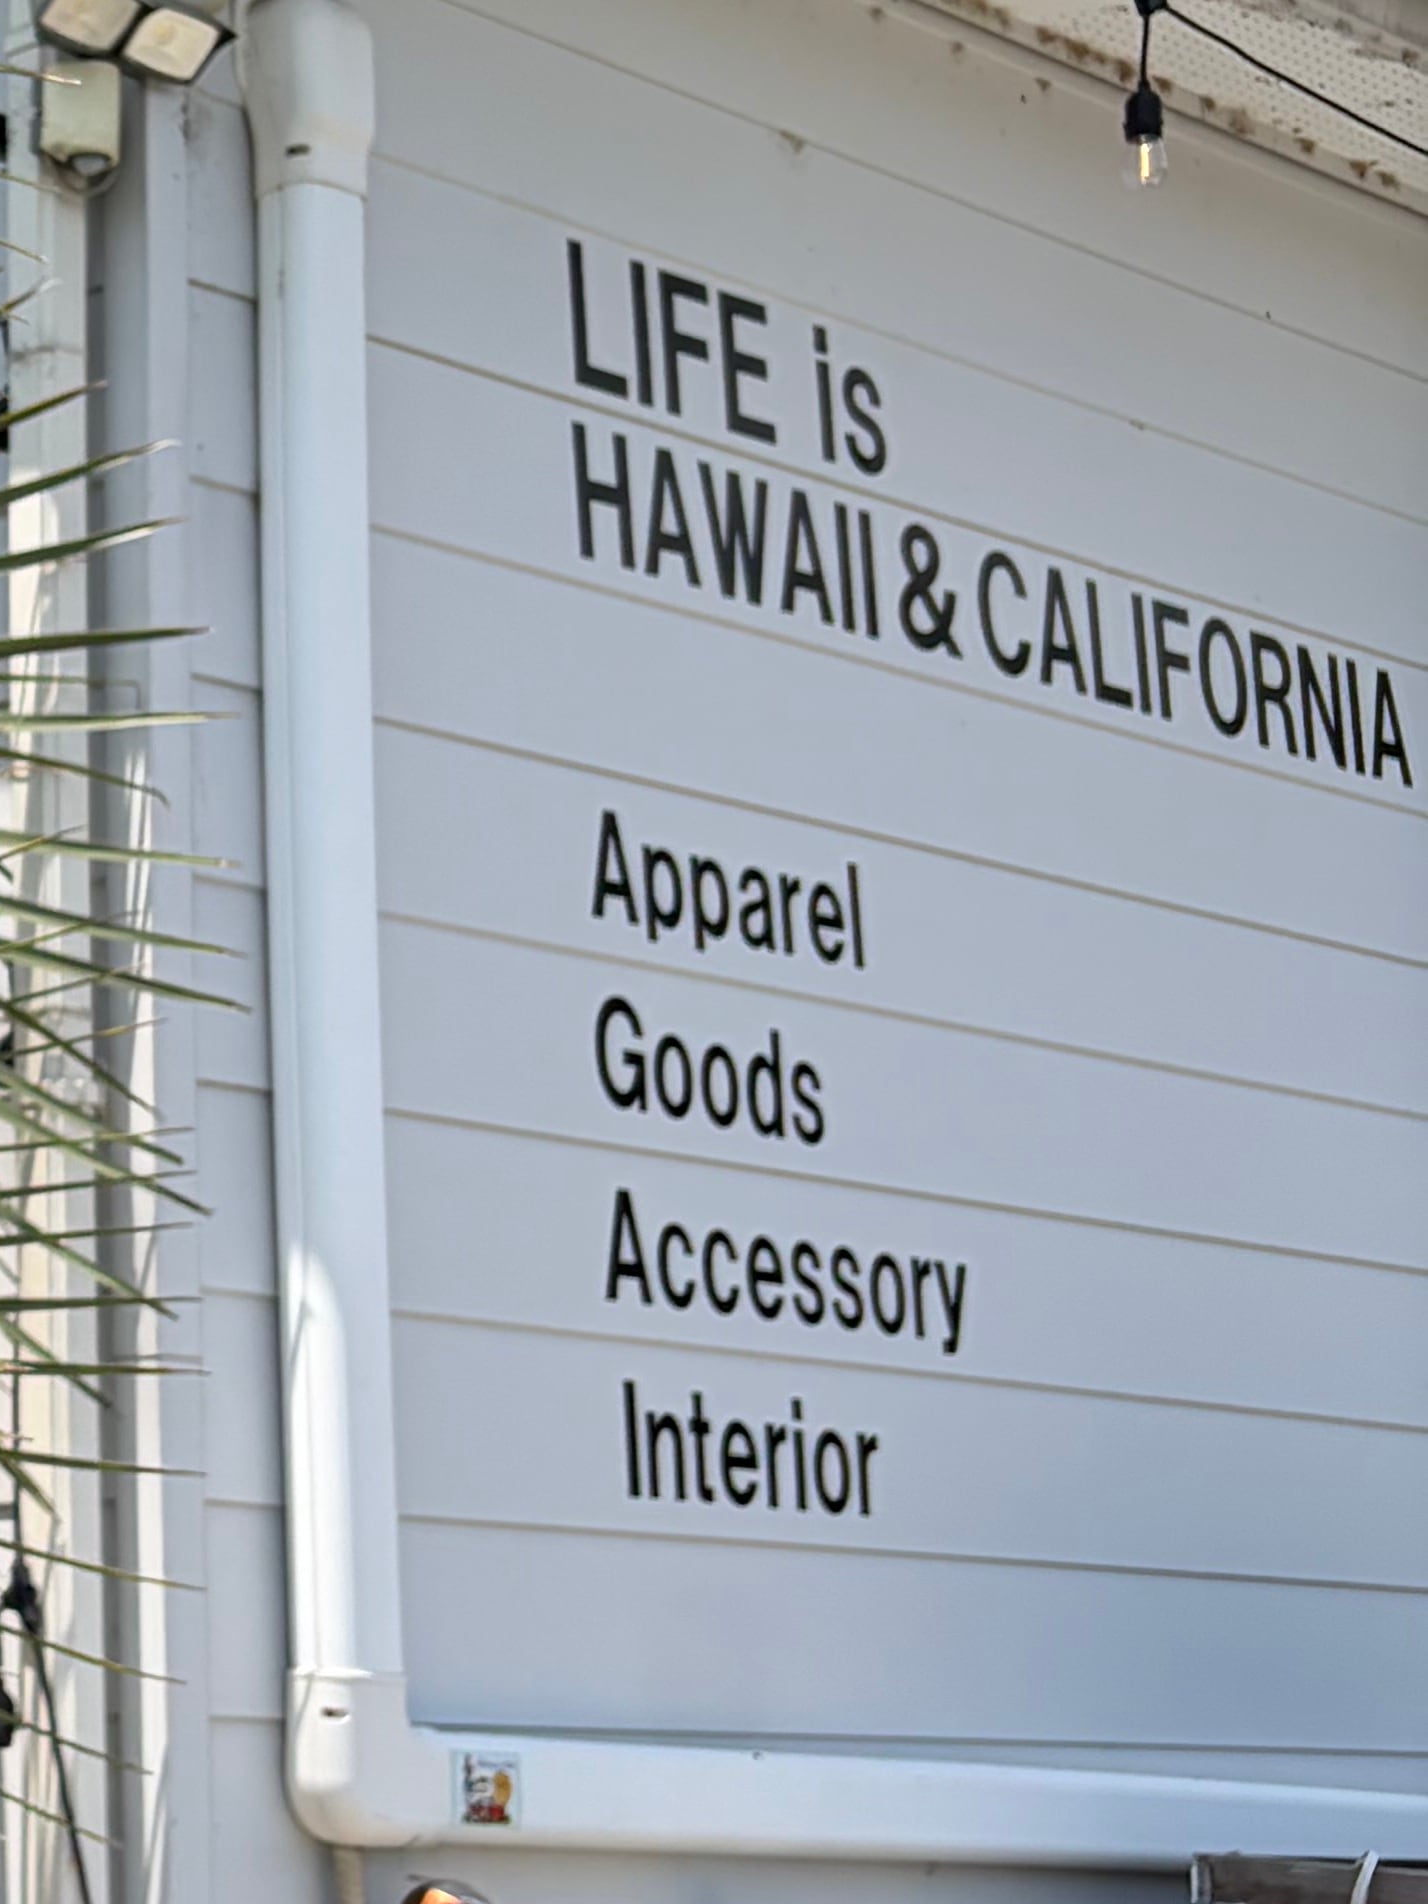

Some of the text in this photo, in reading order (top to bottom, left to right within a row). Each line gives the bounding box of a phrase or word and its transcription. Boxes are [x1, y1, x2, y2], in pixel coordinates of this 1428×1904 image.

[566, 238, 888, 476] LIFE is
[591, 809, 865, 969] Apparel
[594, 995, 826, 1146] Goods
[605, 1188, 967, 1355] Accessory
[622, 1379, 880, 1517] Interior
